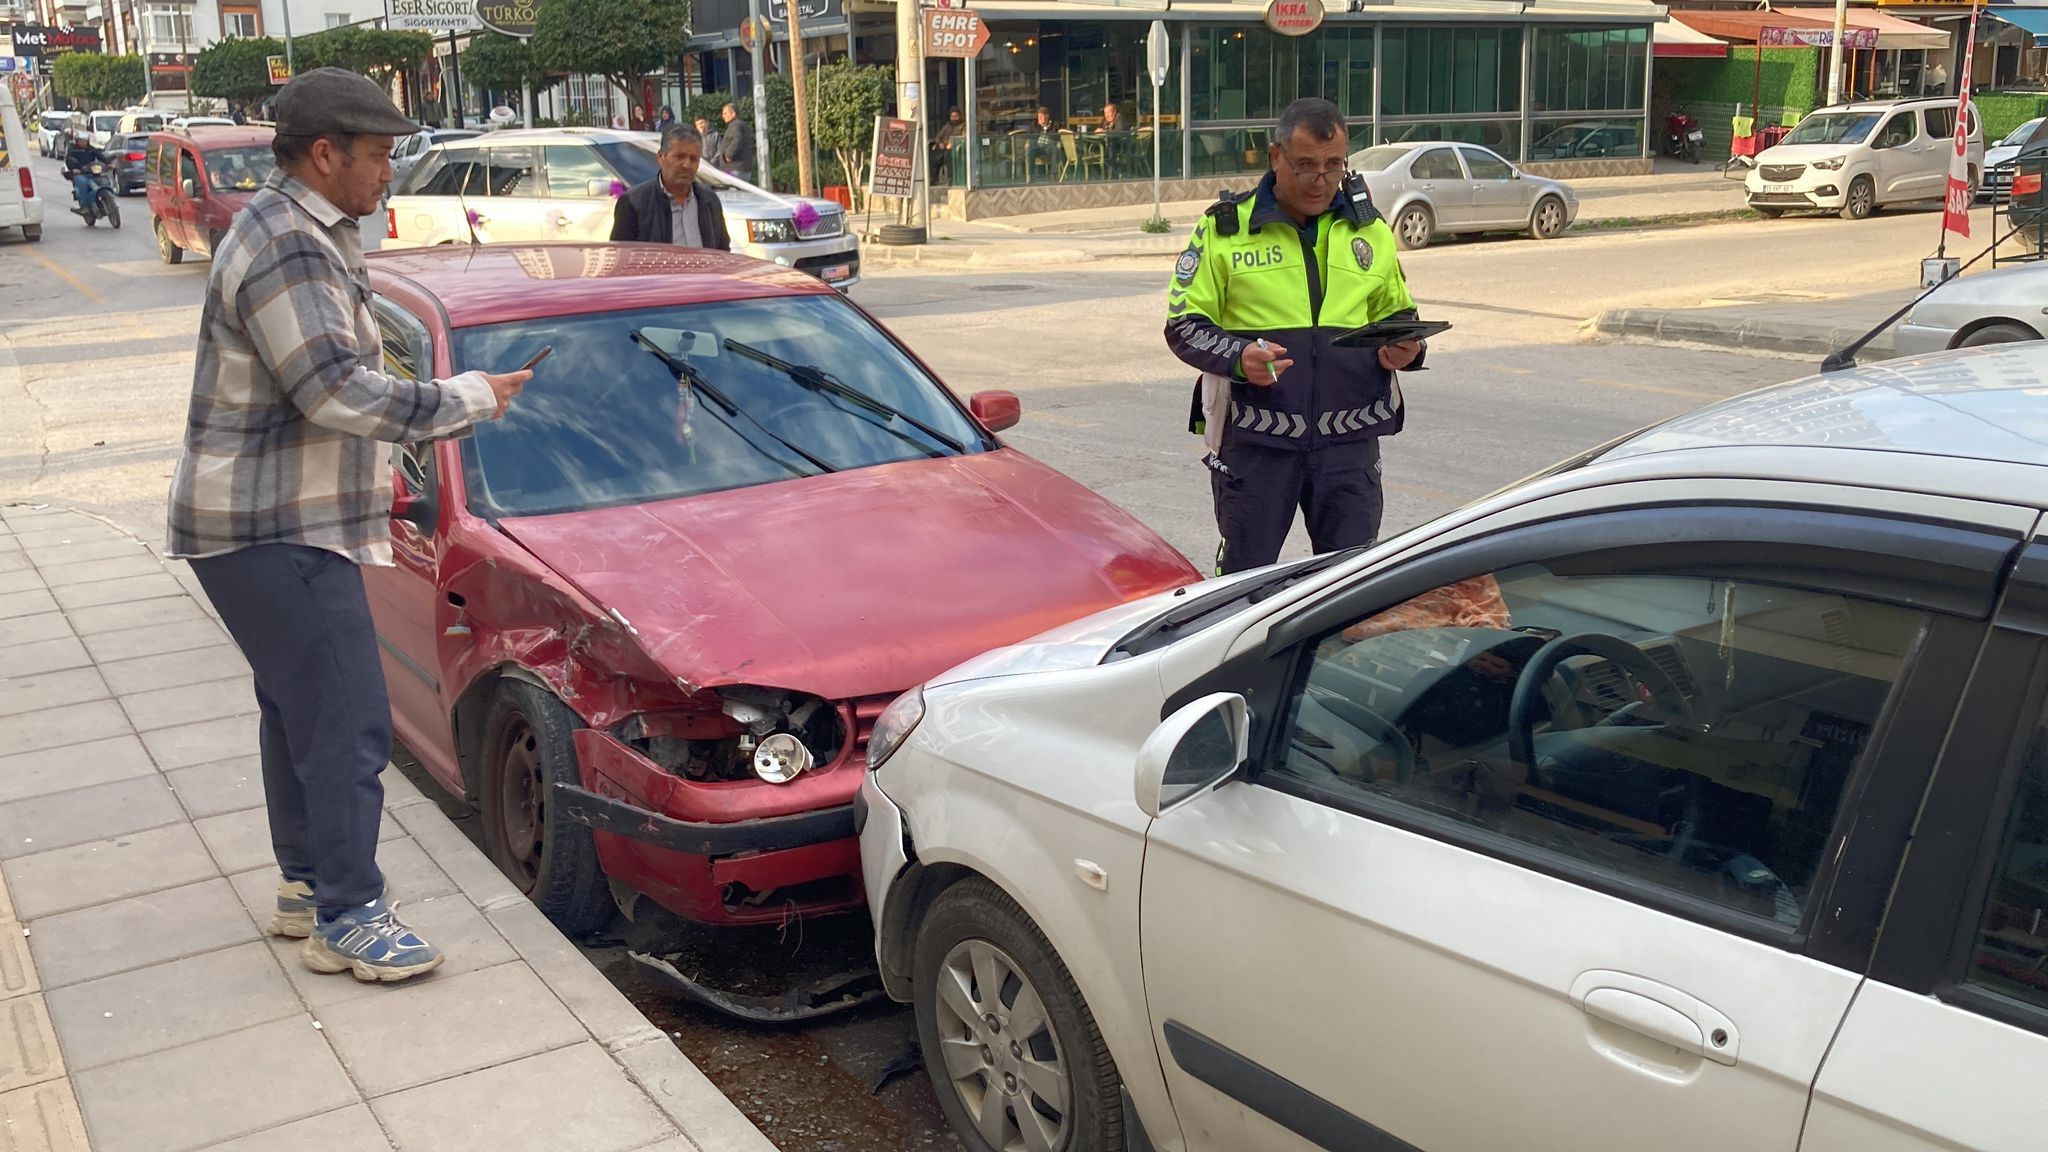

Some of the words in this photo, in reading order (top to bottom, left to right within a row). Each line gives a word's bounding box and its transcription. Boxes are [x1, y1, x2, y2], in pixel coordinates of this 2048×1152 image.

[392, 0, 424, 15] ESER
[931, 15, 978, 31] EMRE
[932, 32, 977, 48] SPOT
